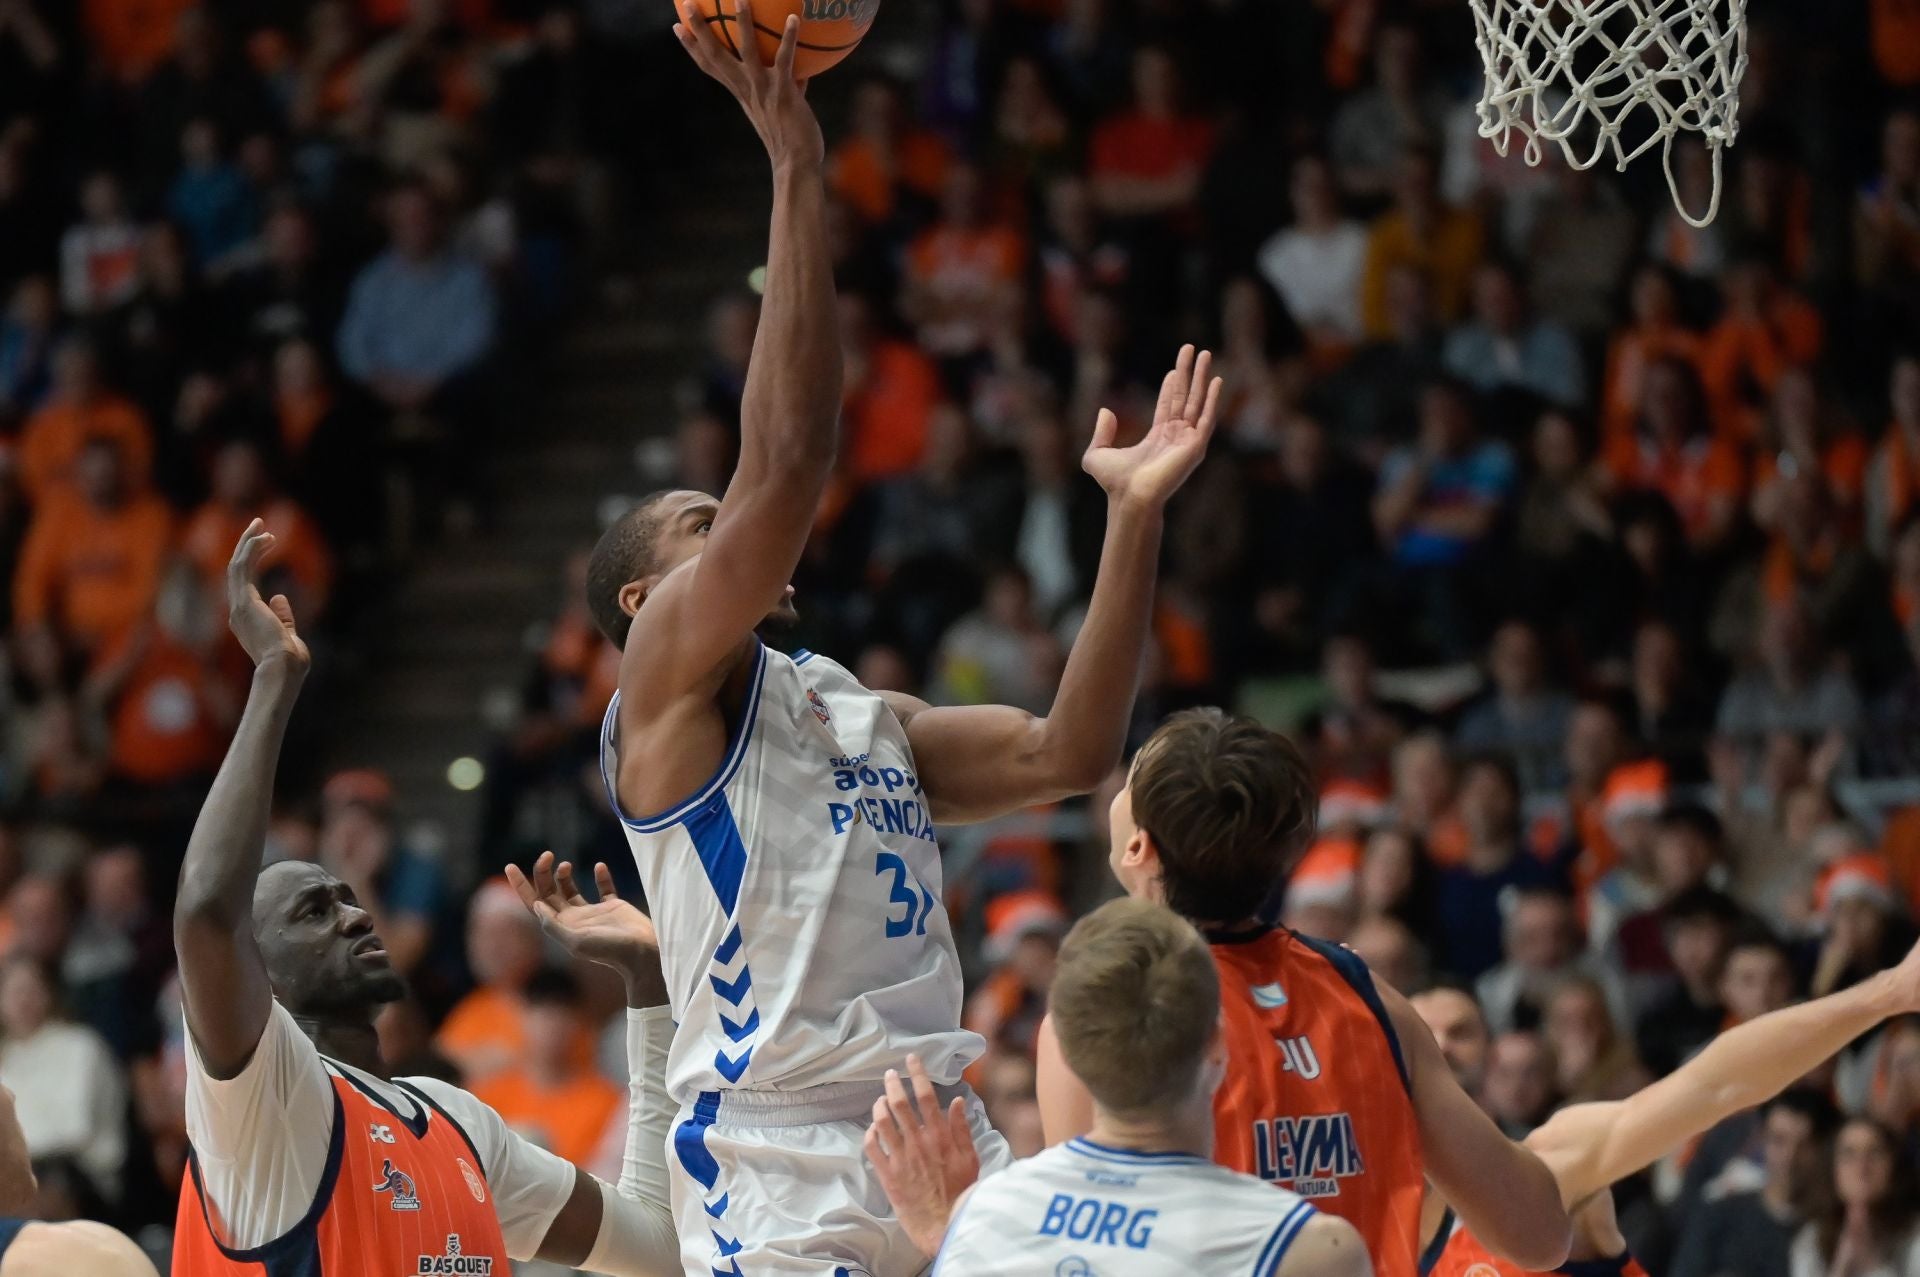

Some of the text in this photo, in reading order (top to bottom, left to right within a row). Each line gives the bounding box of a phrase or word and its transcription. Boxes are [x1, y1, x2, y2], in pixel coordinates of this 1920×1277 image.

[829, 753, 870, 769] súpe
[1039, 1194, 1159, 1249] BORG
[419, 1257, 491, 1275] BASQUET
